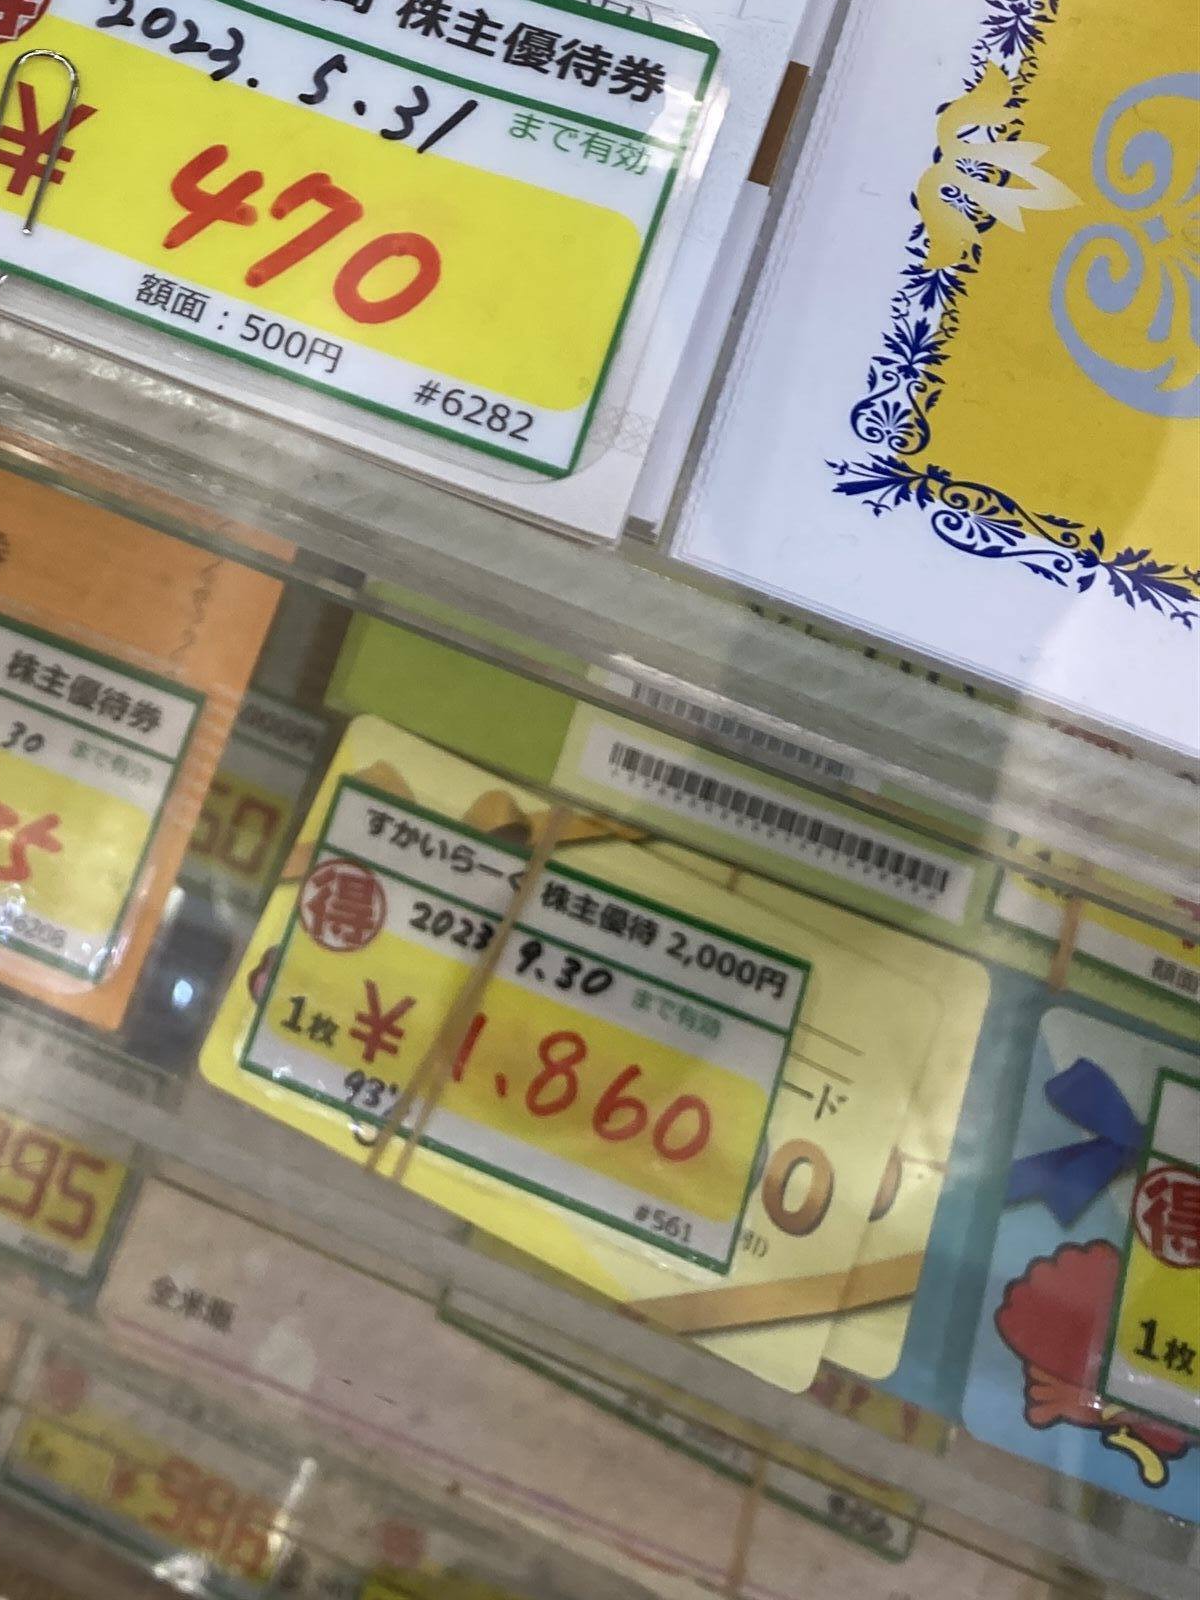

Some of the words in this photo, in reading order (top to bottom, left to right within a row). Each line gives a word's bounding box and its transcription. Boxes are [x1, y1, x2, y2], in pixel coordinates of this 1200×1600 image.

[505, 108, 654, 180] まで有効
[161, 143, 444, 328] 470
[410, 381, 538, 444] #6282
[4, 647, 164, 734] 株主優待券
[304, 863, 386, 950] 得
[364, 807, 530, 896] すかいらーく
[540, 880, 659, 951] 株主優待
[668, 929, 789, 1000] 2,000円
[406, 899, 616, 998] 20239.30
[278, 994, 339, 1048] 1枚
[633, 1202, 694, 1246] #561
[1133, 1317, 1197, 1377] 1枚
